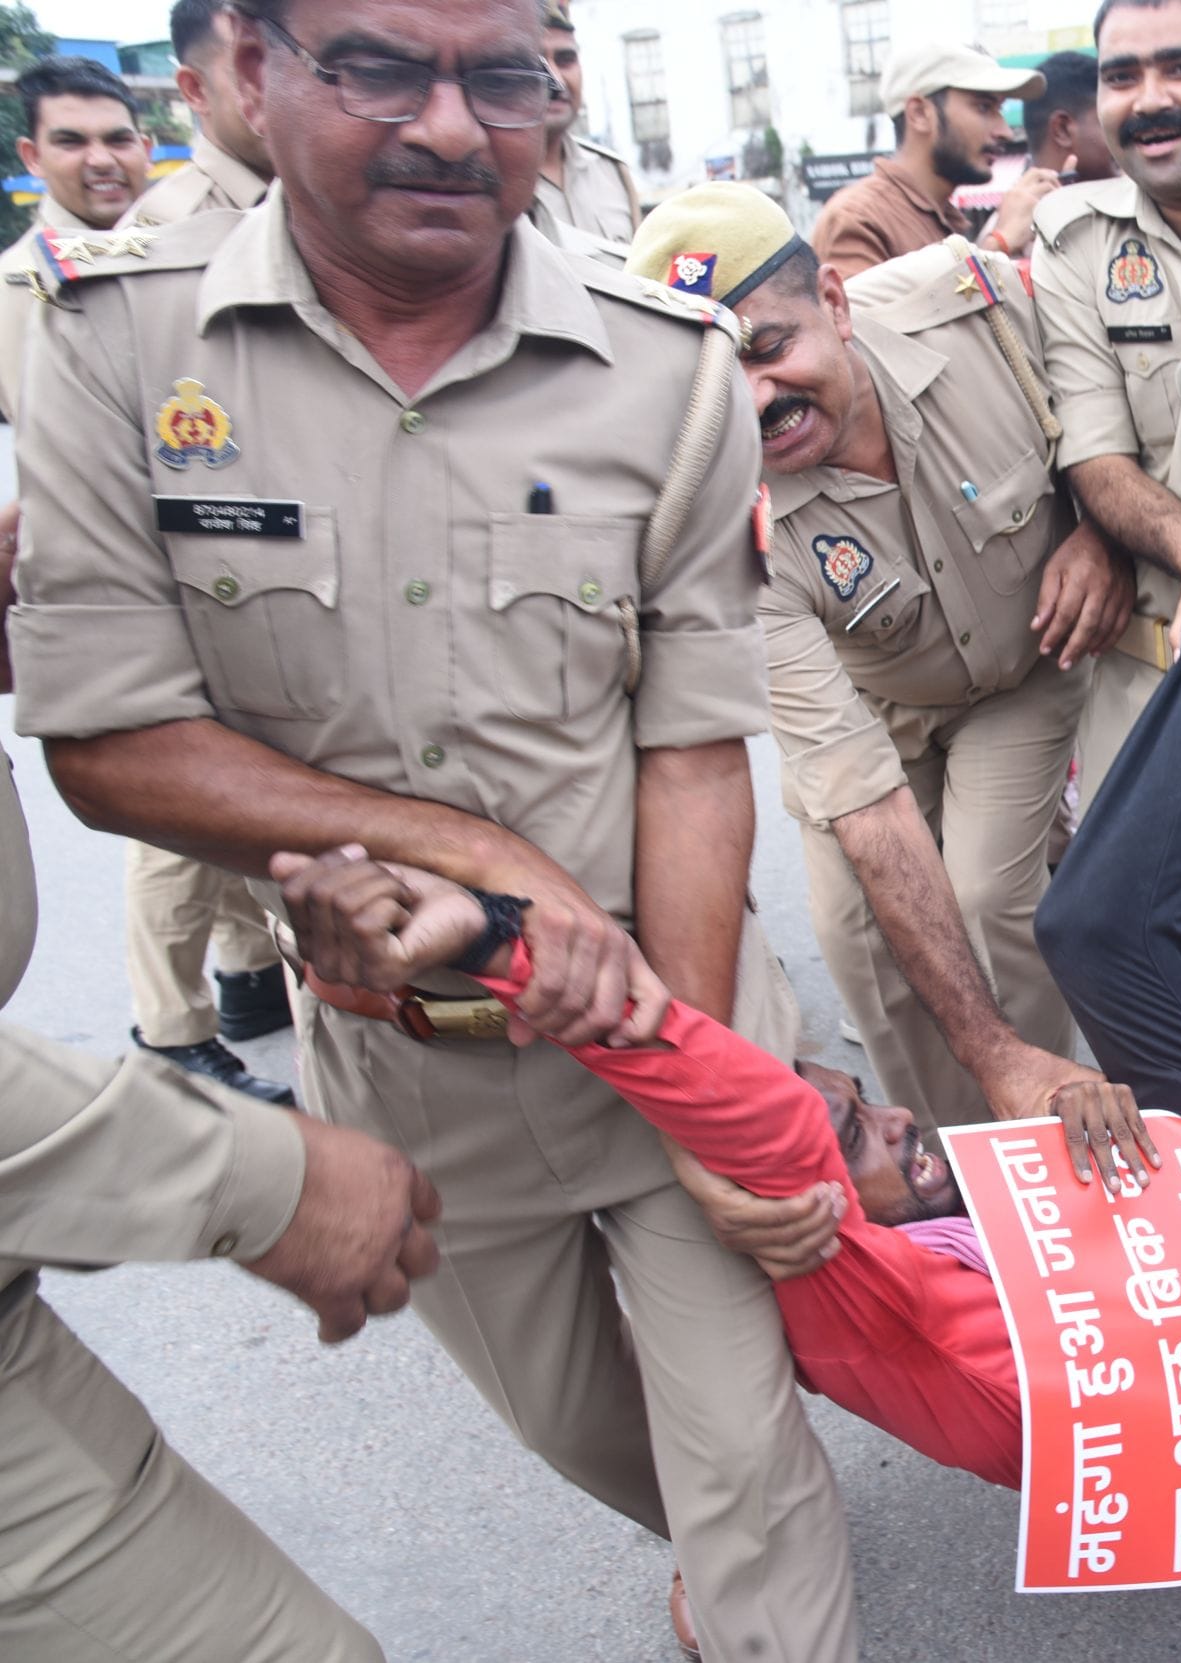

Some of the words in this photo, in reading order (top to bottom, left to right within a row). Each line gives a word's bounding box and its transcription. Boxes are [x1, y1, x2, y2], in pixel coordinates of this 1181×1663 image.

[991, 1138, 1077, 1277] जनता
[1047, 1289, 1135, 1408] हुआ
[1056, 1423, 1130, 1578] महंगा
